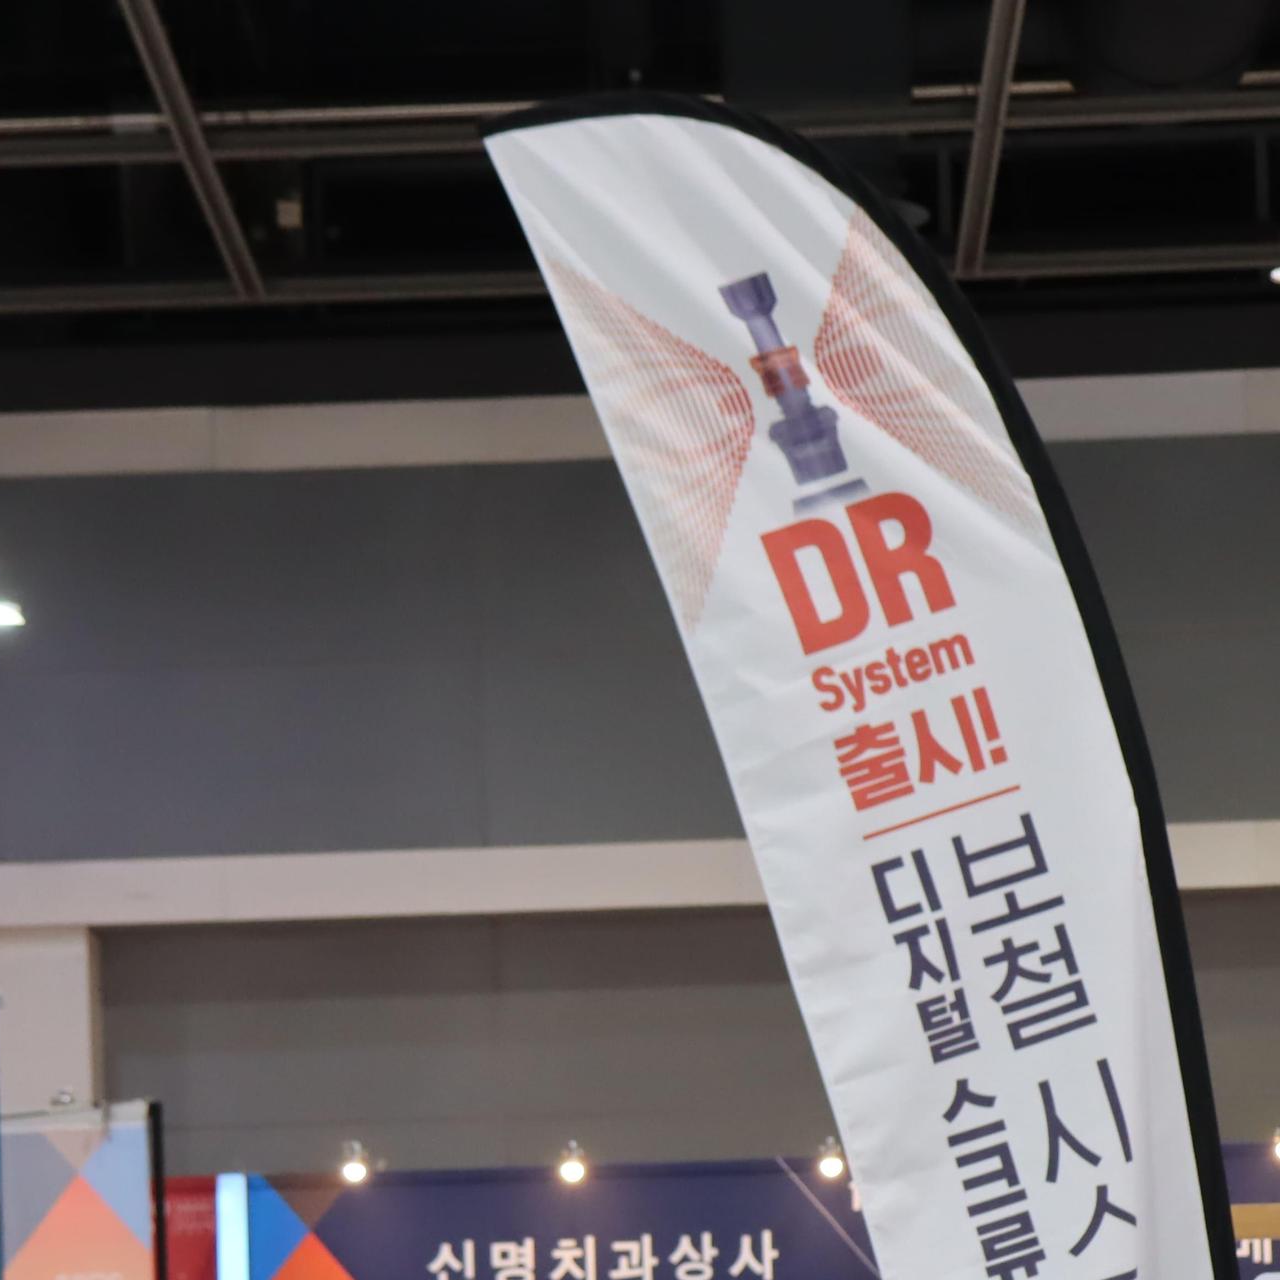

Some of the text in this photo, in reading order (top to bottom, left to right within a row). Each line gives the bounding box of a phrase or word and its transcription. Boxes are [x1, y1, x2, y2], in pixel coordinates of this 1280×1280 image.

[760, 491, 957, 655] DR
[810, 633, 974, 714] System
[833, 685, 1008, 813] 출시!
[871, 847, 981, 1064] 디지털
[951, 812, 1098, 1052] 보철
